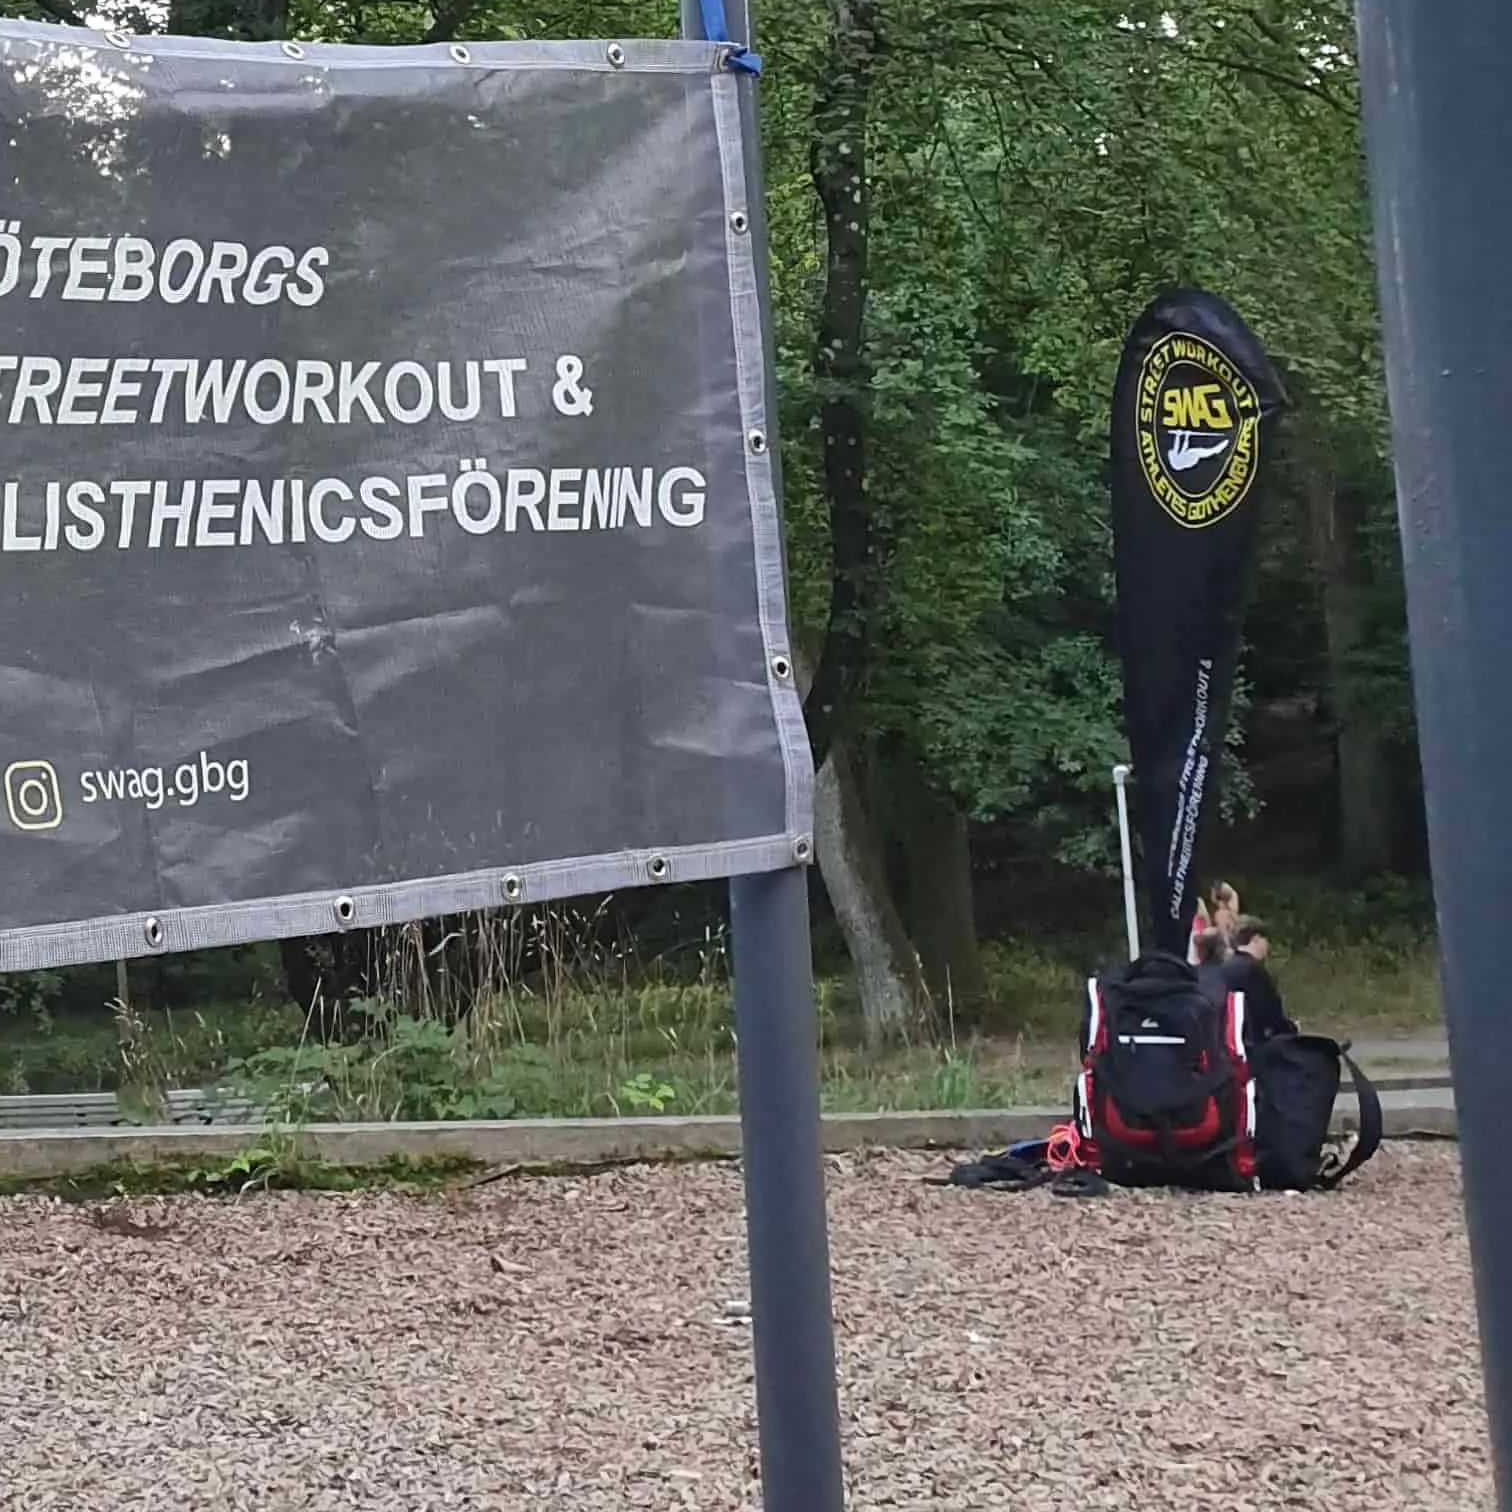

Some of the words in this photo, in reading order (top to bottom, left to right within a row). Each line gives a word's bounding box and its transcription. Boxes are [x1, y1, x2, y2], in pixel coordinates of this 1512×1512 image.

[551, 354, 594, 417] &
[1140, 344, 1170, 423] STREET
[1171, 339, 1253, 408] WORKOUT
[1163, 384, 1232, 428] SWAG
[80, 751, 249, 809] swag.gbg
